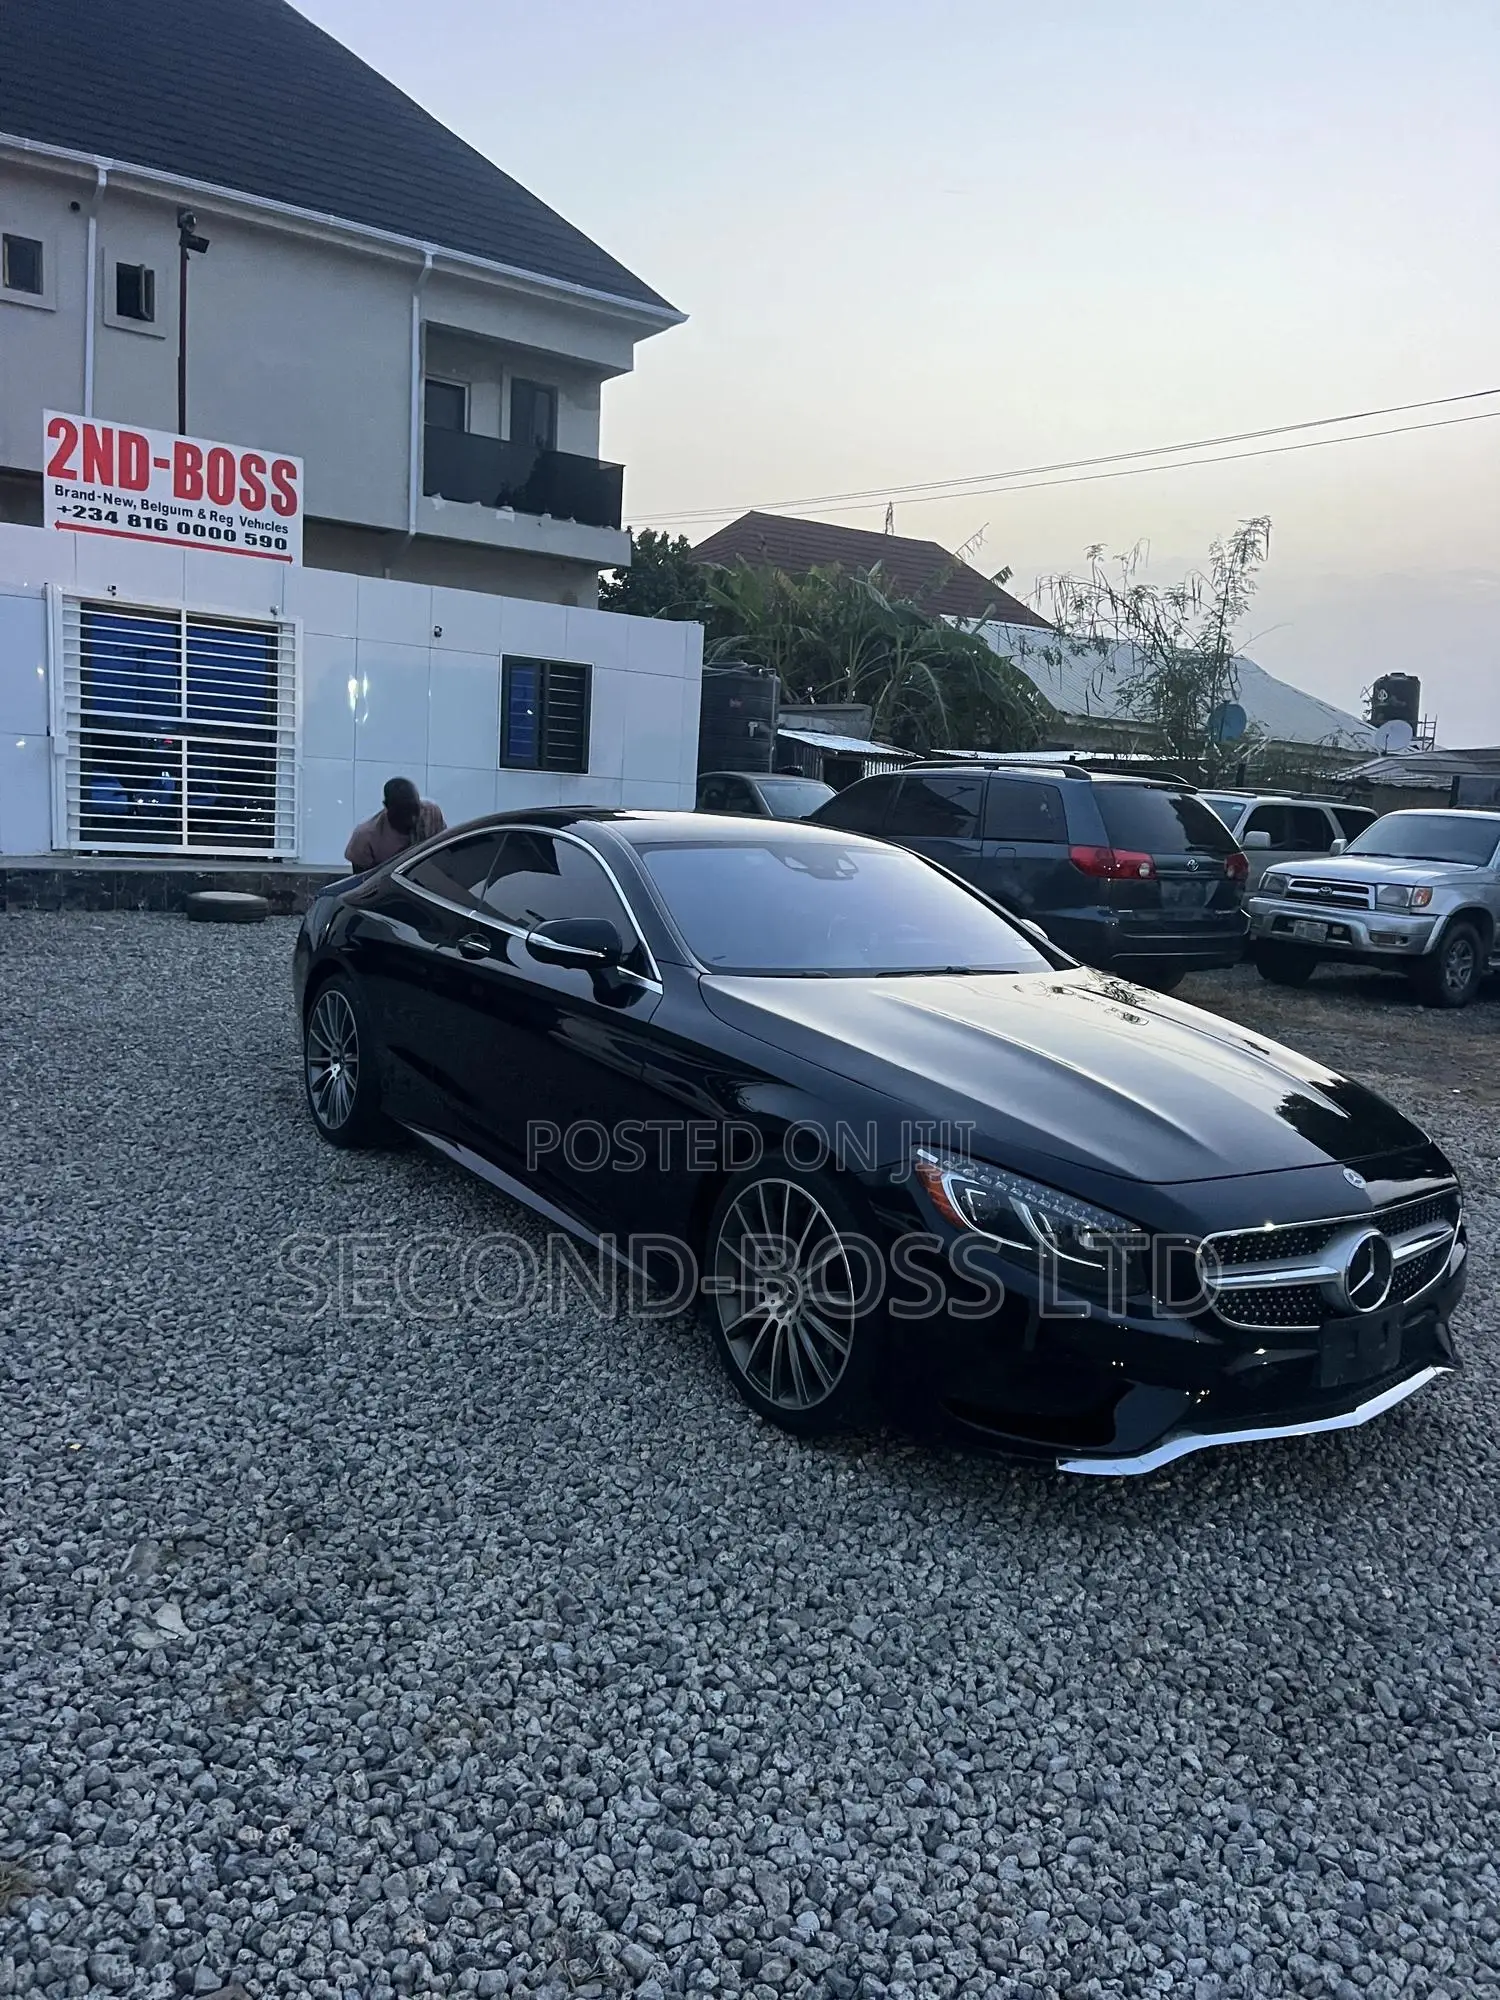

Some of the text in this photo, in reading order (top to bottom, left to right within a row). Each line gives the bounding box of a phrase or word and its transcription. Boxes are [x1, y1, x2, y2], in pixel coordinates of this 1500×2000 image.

[47, 417, 298, 517] 2ND-BOSS
[56, 505, 287, 550] +234 816 0000 590
[197, 508, 207, 520] &
[210, 510, 234, 527] Reg
[239, 515, 289, 534] Vehicles
